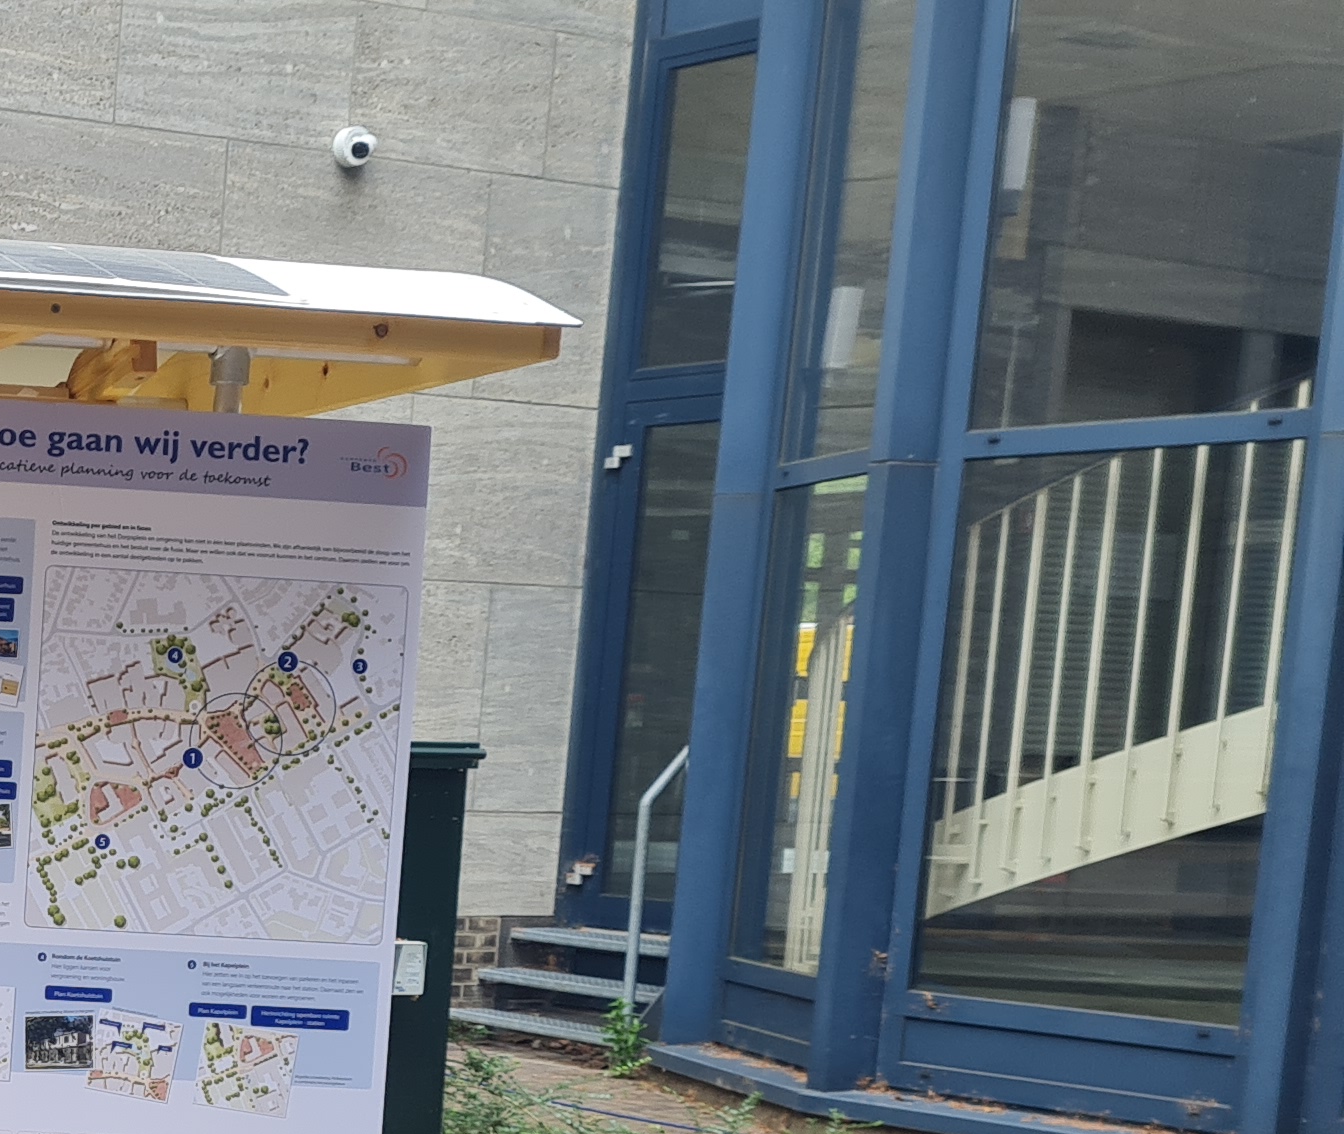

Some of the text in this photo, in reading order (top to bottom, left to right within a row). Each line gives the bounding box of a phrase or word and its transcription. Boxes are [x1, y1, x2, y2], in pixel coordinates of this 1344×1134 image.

[47, 431, 123, 457] gaan
[134, 430, 180, 465] wij
[189, 435, 310, 465] verder?
[60, 464, 134, 481] planning
[140, 470, 174, 481] voor
[178, 470, 198, 482] de
[203, 471, 272, 487] toekomst
[350, 462, 390, 474] Best
